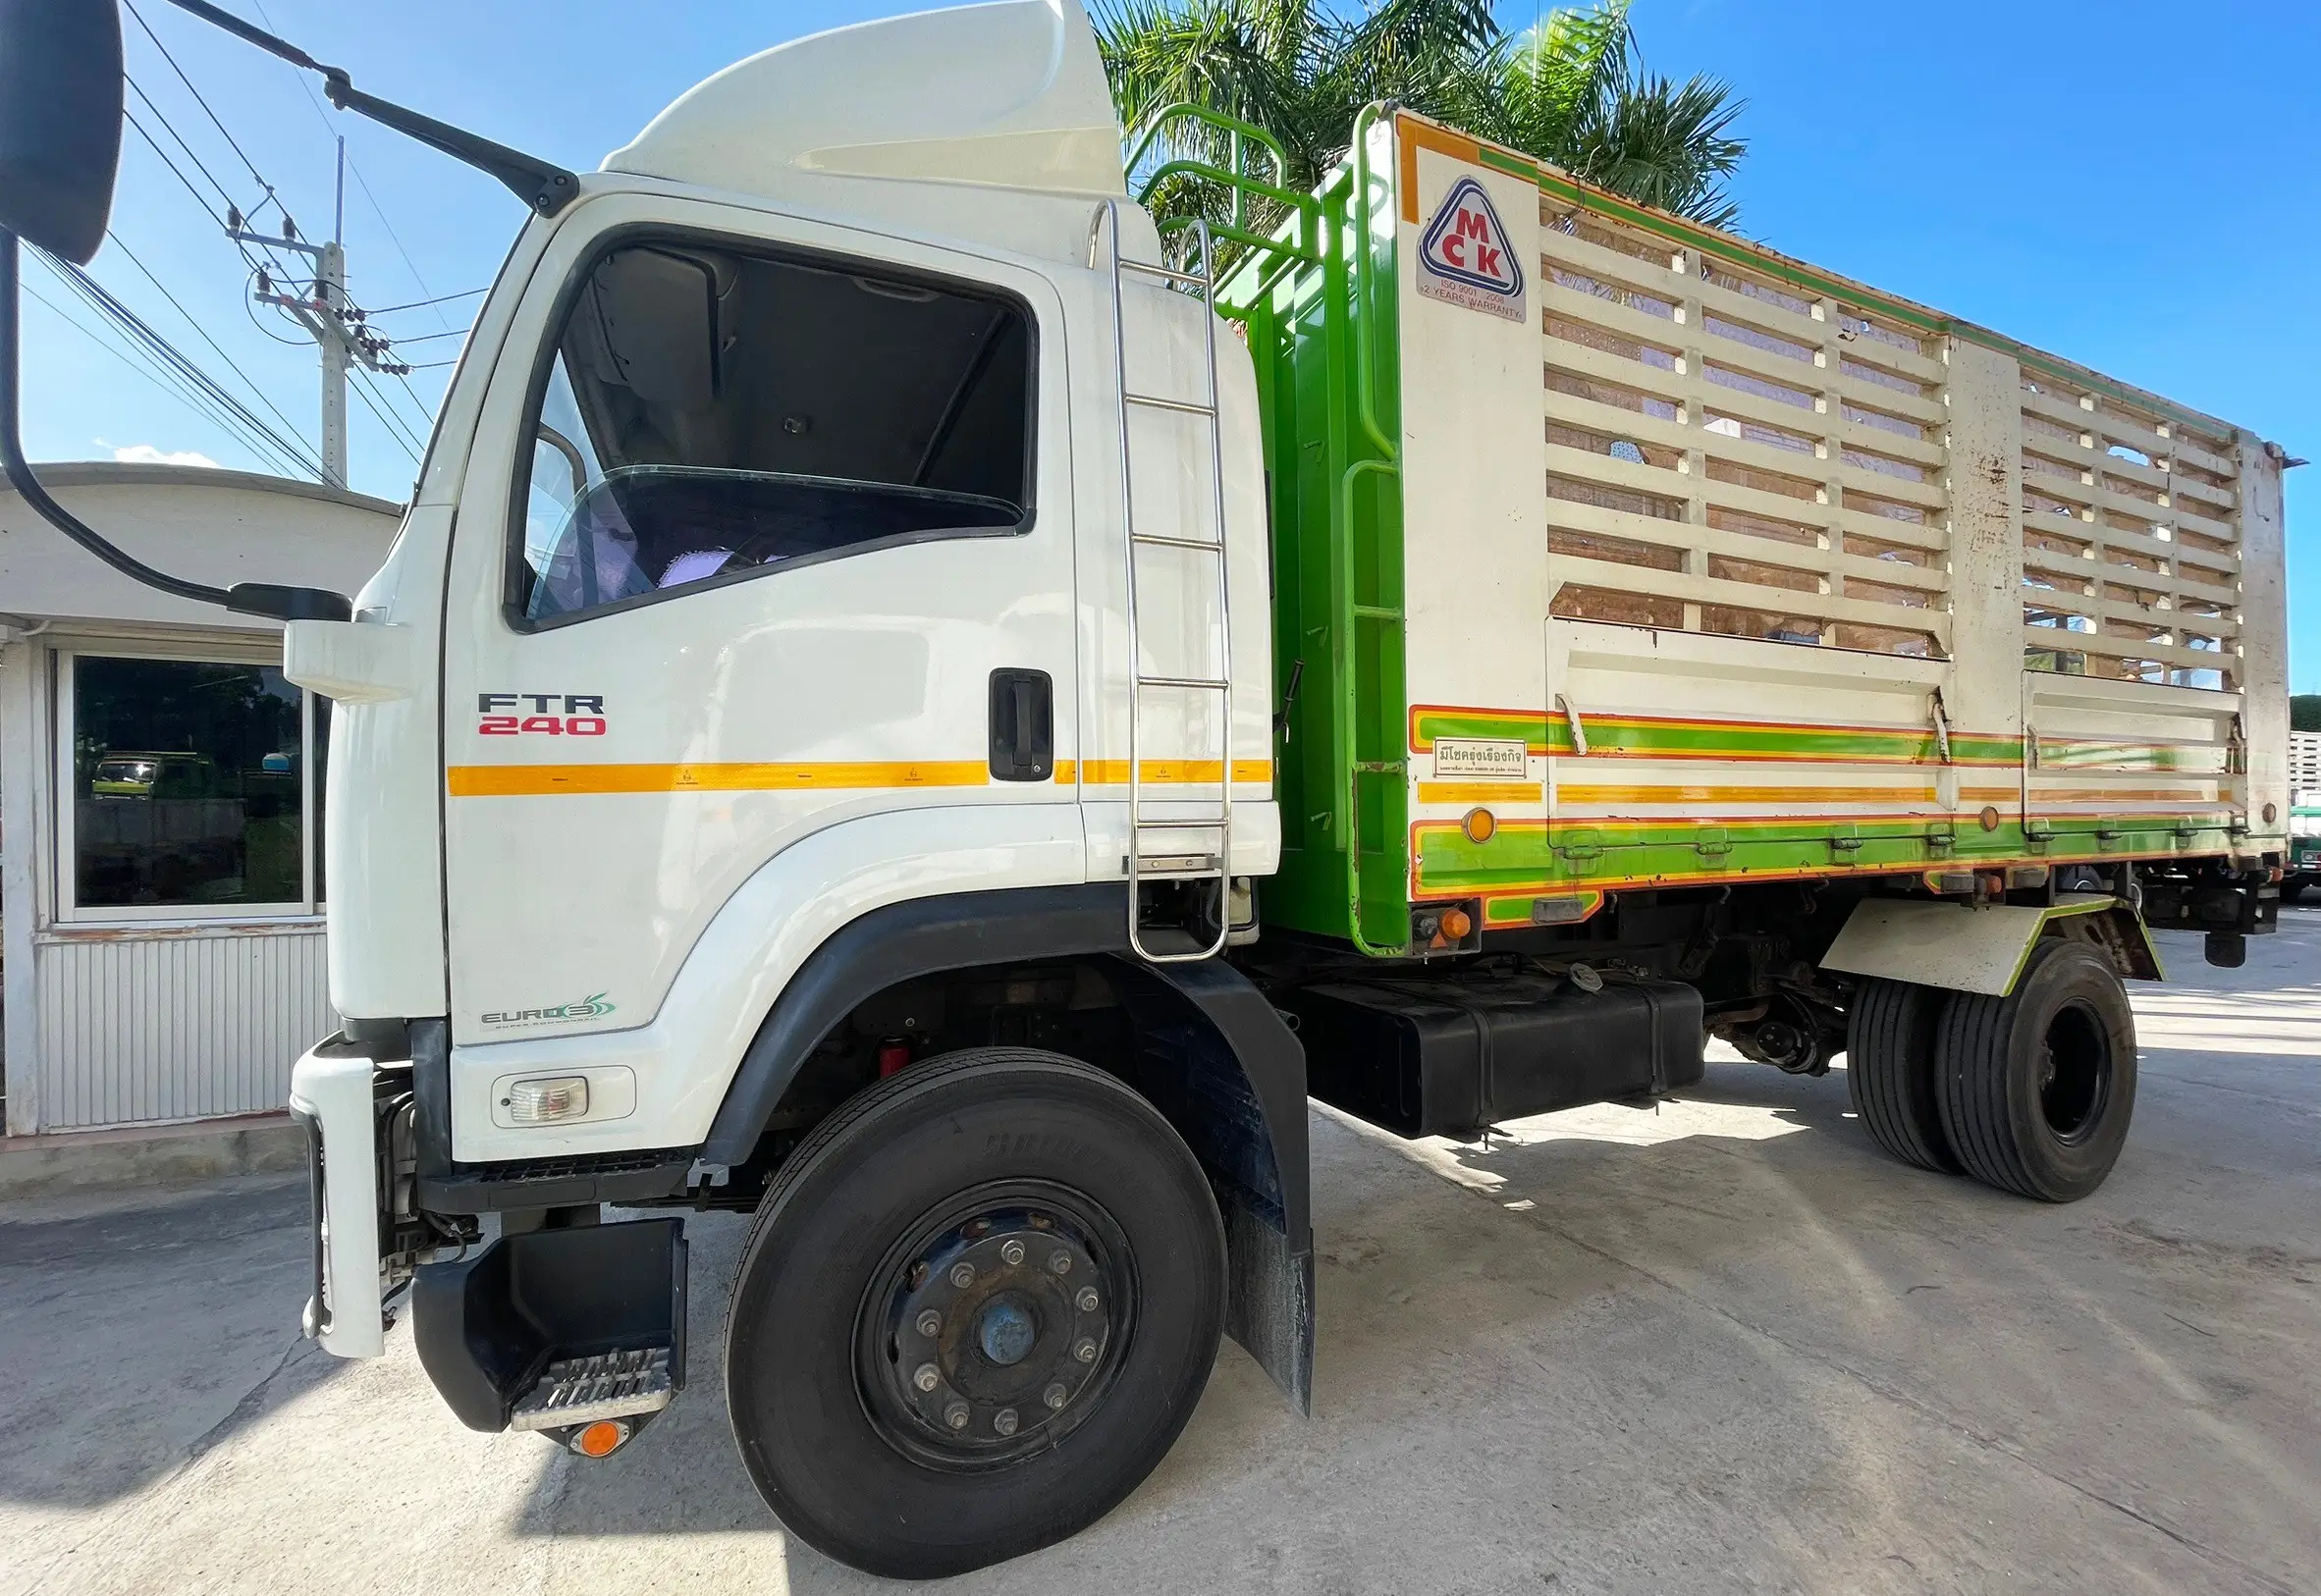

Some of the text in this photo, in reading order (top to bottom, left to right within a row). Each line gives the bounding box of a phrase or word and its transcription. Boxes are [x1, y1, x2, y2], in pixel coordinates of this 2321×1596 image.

[1440, 279, 1455, 291] ISO
[1459, 284, 1478, 297] 9001
[1433, 288, 1465, 304] YEARS
[1468, 296, 1520, 319] WARRANTY
[478, 693, 605, 715] FTR
[478, 716, 607, 736] 240
